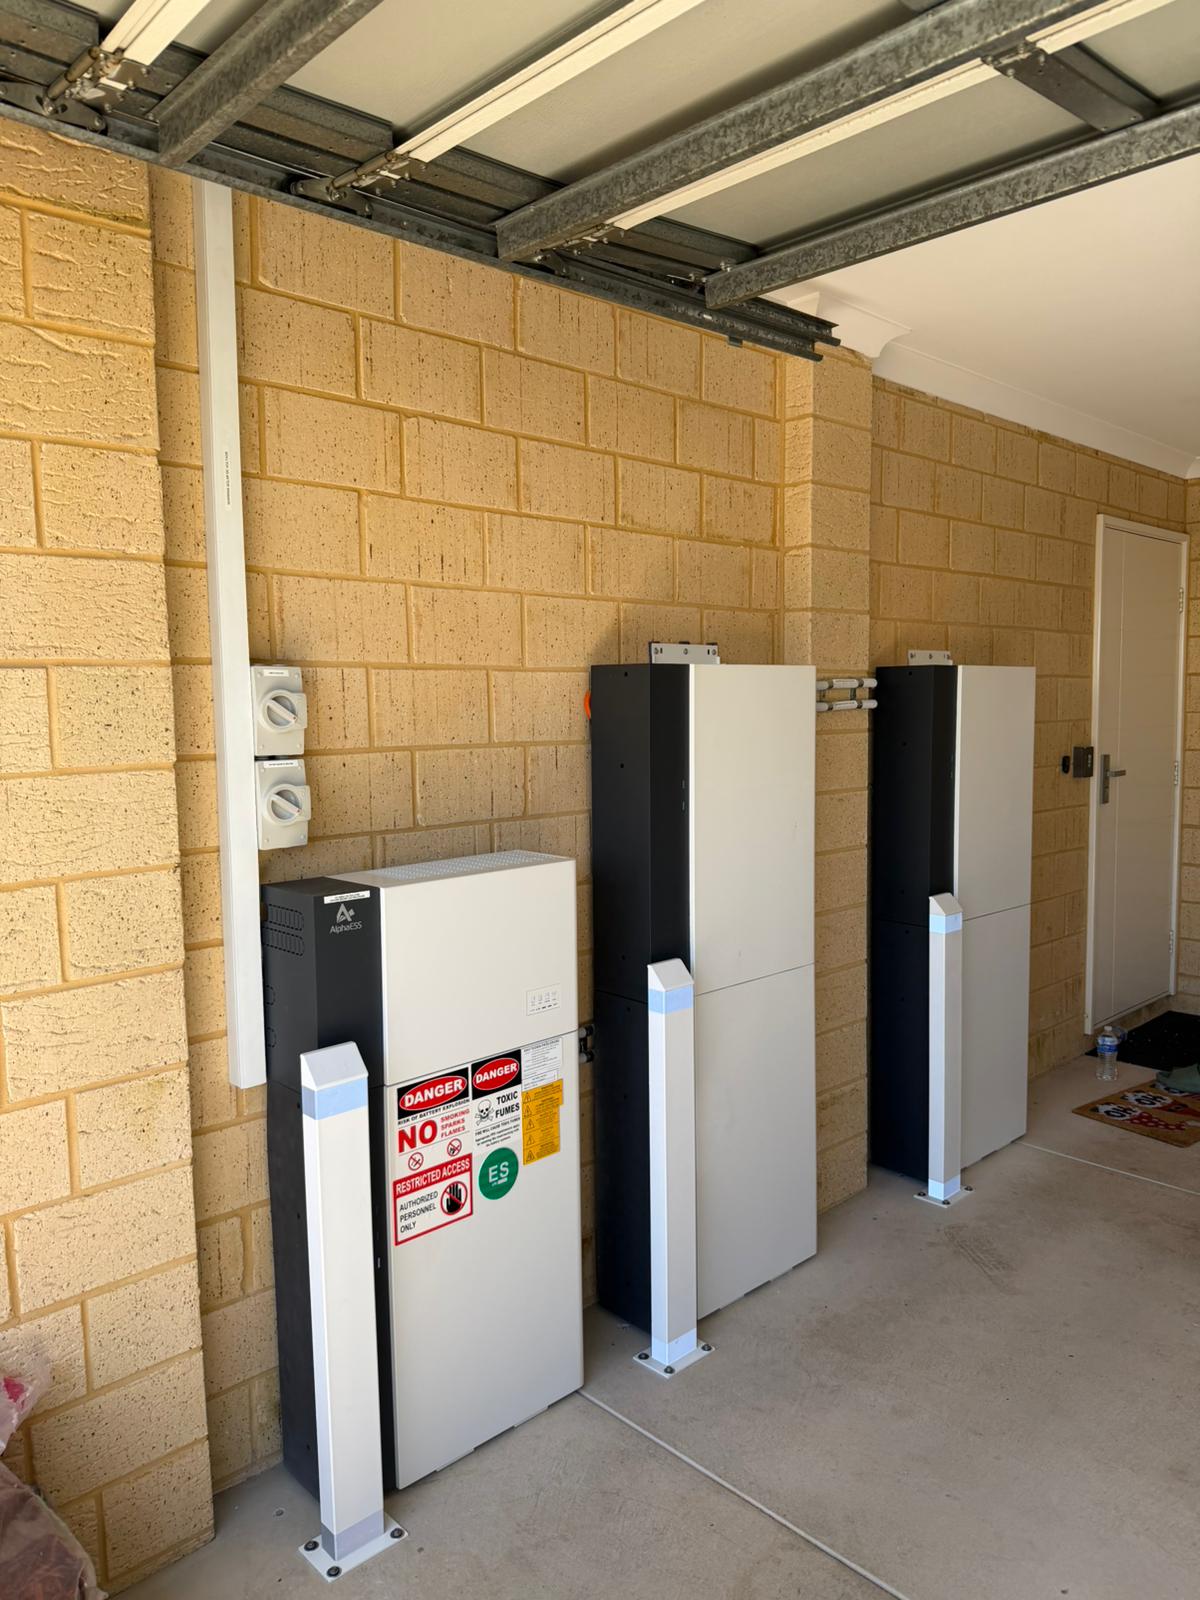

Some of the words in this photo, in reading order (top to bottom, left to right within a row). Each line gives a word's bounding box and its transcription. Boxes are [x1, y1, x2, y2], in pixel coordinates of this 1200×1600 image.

[330, 920, 362, 935] AlphaESS
[475, 1063, 518, 1084] DANGER
[404, 1079, 463, 1108] DANGER
[496, 1090, 518, 1105] TOXIC
[420, 1108, 441, 1118] BATTERY
[443, 1099, 470, 1111] EXPLOSION
[440, 1108, 470, 1122] SMOKING
[495, 1102, 520, 1119] FUMES
[440, 1125, 466, 1138] FLAMES
[441, 1117, 465, 1130] SPARKS
[398, 1119, 437, 1153] NO
[395, 1168, 441, 1195] RESTRICTED
[441, 1157, 471, 1178] ACCESS
[488, 1161, 510, 1183] ES
[399, 1191, 439, 1212] AUTHORIZED
[399, 1202, 437, 1222] PERSONNEL
[400, 1221, 417, 1234] ONLY
